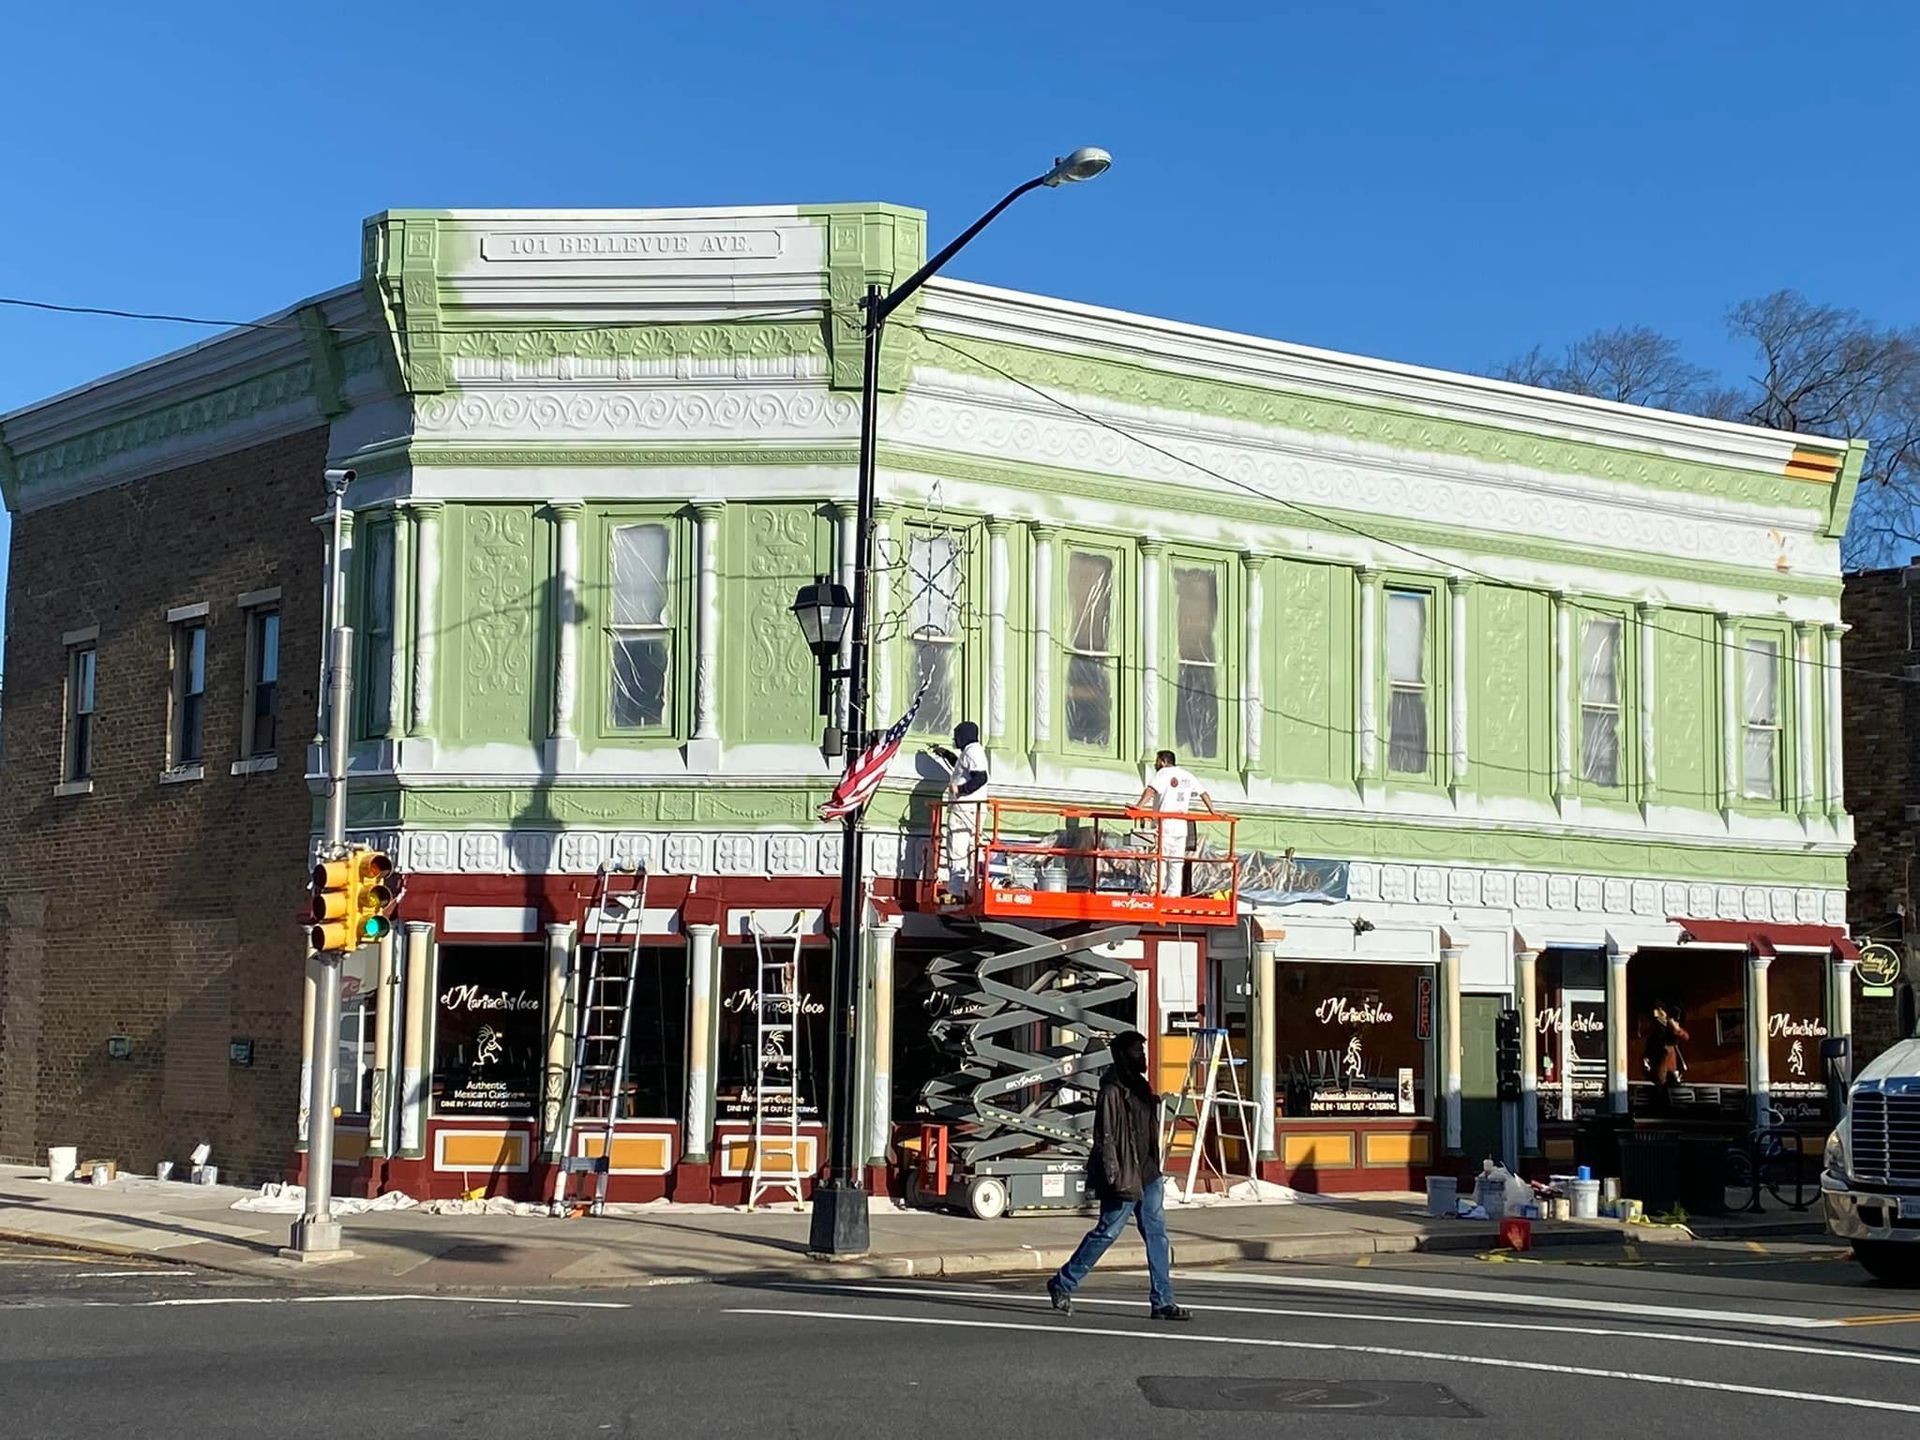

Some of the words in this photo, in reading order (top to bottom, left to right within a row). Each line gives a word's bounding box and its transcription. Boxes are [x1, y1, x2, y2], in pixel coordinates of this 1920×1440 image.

[510, 238, 548, 254] 101
[560, 235, 689, 255] BELLEVUE
[700, 235, 753, 254] AVE.
[1111, 896, 1155, 910] SKYJACK
[440, 987, 454, 1004] el
[447, 985, 517, 1011] Mariachi
[517, 990, 539, 1010] loco
[724, 991, 737, 1008] el
[801, 993, 825, 1014] loco
[1315, 1000, 1327, 1018] el
[1321, 997, 1376, 1025] Mariachi
[1376, 1002, 1393, 1022] loco
[1420, 980, 1431, 1036] OPEN
[466, 1081, 507, 1090] Authentic
[1005, 1073, 1043, 1090] SKYJACK
[454, 1090, 487, 1099] Mexican
[1313, 1092, 1345, 1101] Authentic
[1345, 1092, 1372, 1101] Mexican
[1373, 1092, 1395, 1101] Cuisine
[440, 1100, 456, 1108] DINE
[1310, 1103, 1325, 1111] DINE
[1336, 1103, 1351, 1111] TAKE
[1352, 1103, 1365, 1111] OUT
[1047, 1161, 1084, 1173] SKYJACK
